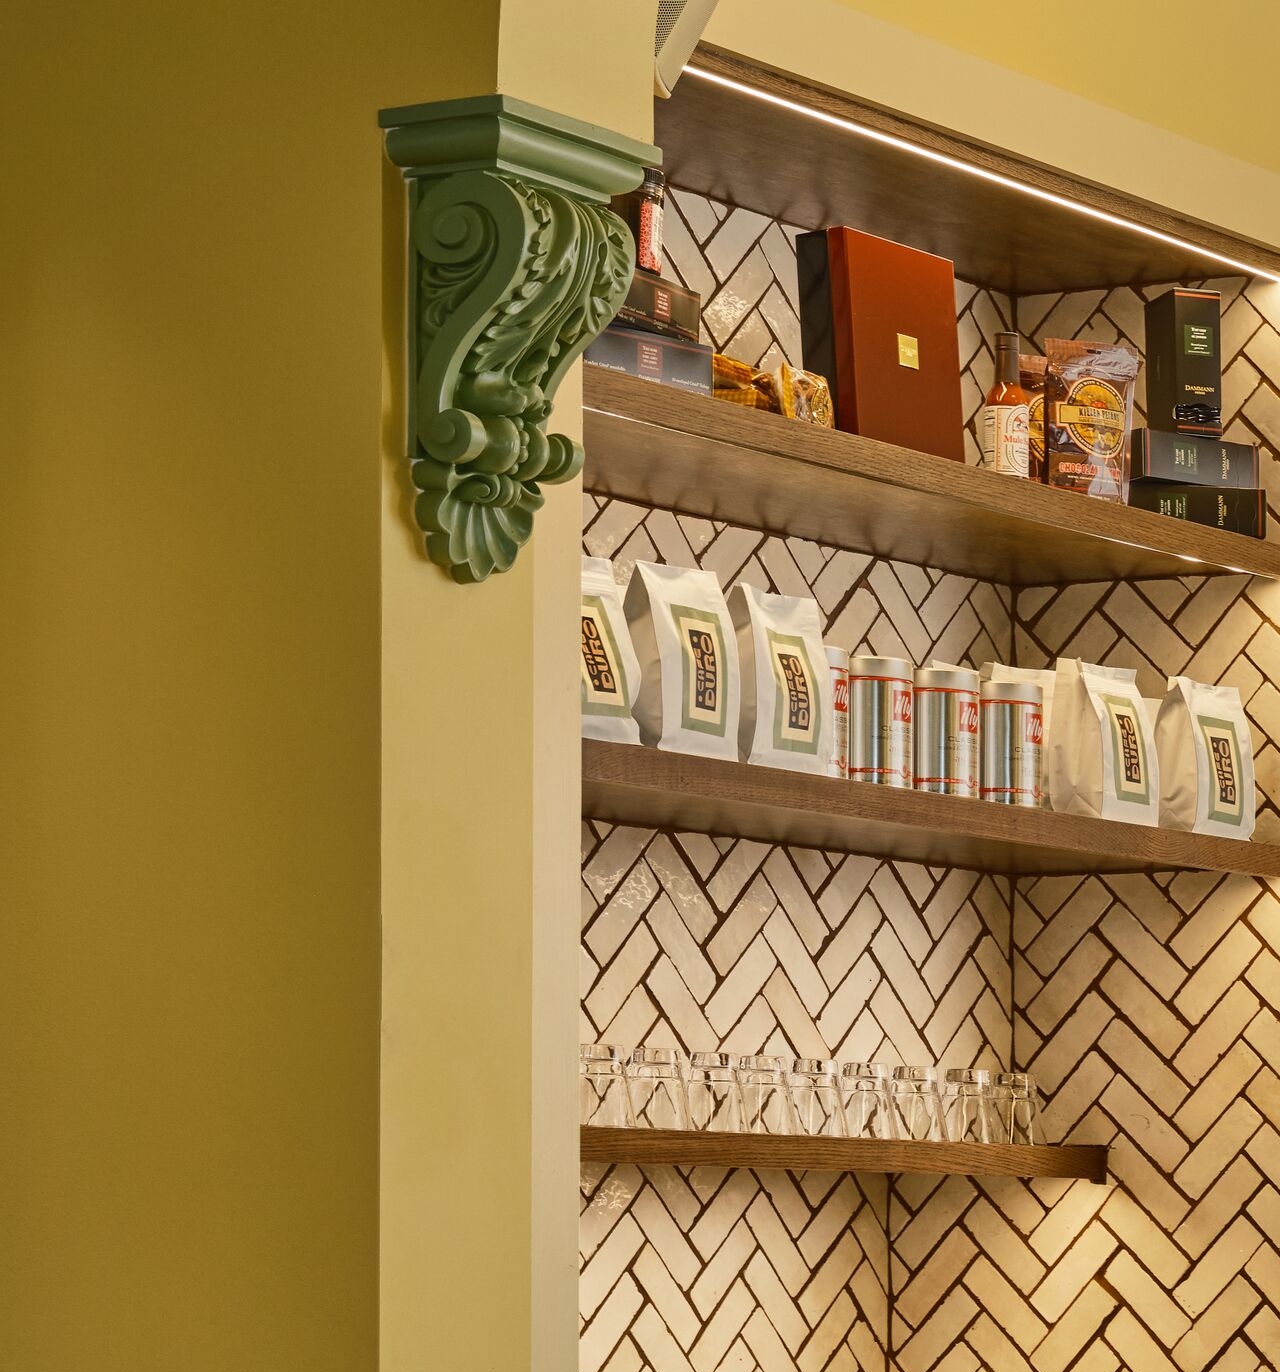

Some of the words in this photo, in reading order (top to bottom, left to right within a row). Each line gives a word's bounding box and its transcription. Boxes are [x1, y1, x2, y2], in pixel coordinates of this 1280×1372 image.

[1185, 384, 1215, 393] DAMMANN
[1217, 494, 1225, 526] DAMMANN
[582, 620, 615, 690] DURO
[700, 634, 716, 708] DURO
[790, 657, 809, 727] DURO
[1123, 717, 1141, 781] DURO
[1218, 740, 1236, 802] DURO
